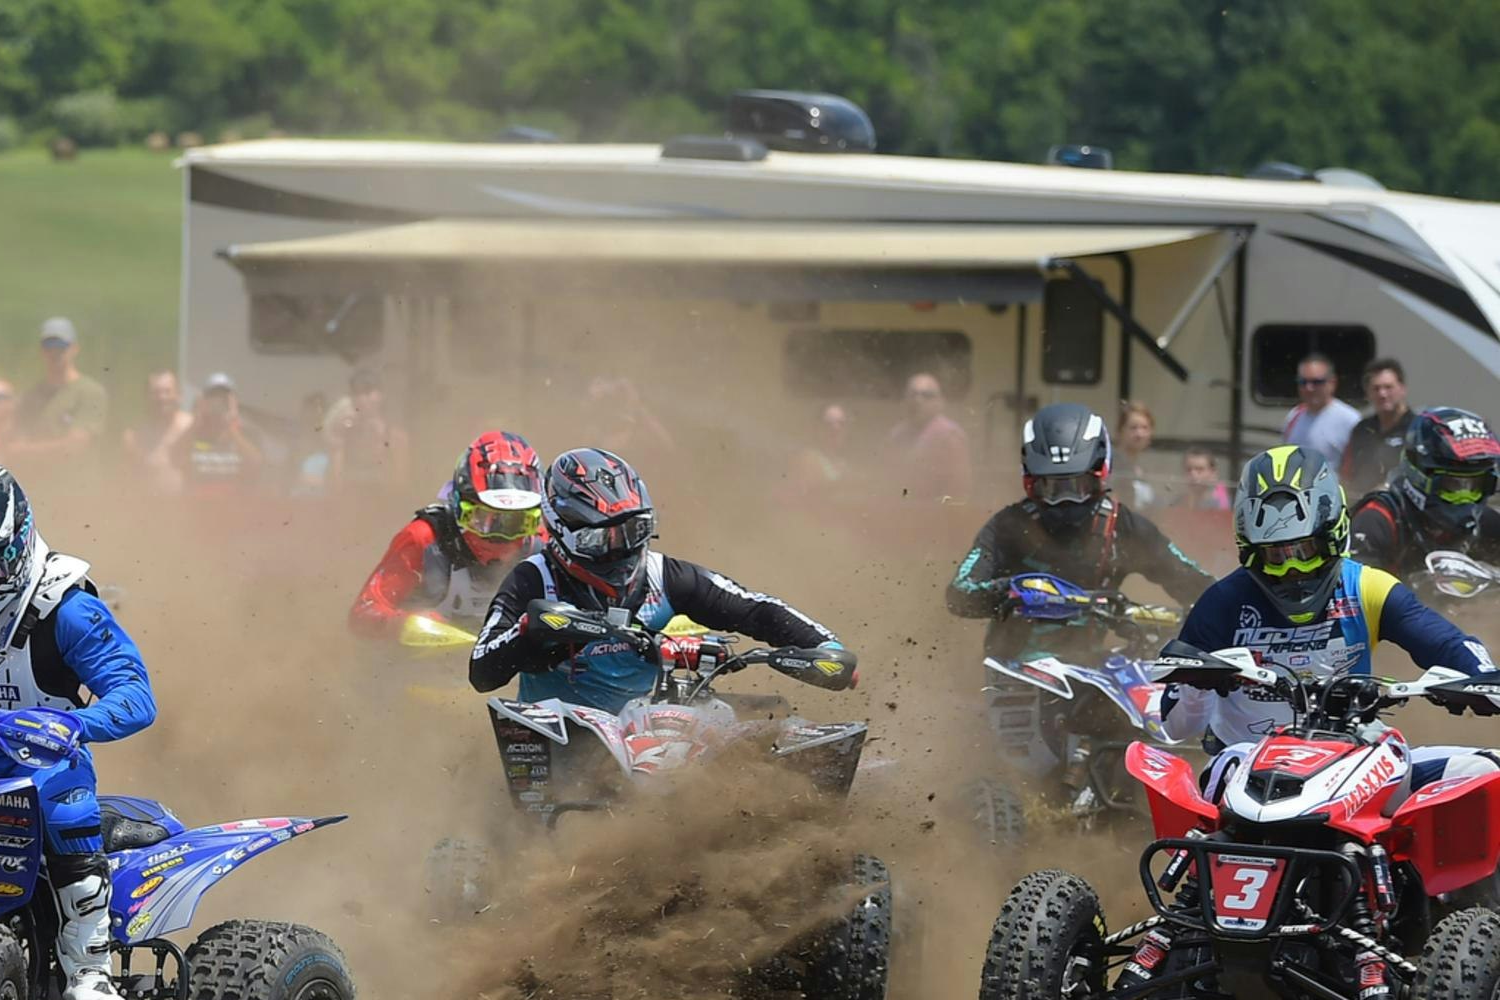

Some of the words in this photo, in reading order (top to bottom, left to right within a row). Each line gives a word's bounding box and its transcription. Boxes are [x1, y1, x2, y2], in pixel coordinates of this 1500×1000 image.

[1232, 620, 1336, 646] MOOSE
[1267, 640, 1329, 654] RACING
[1463, 684, 1500, 693] ACER
[507, 743, 542, 753] ACTION
[1341, 755, 1395, 821] MAXXIS
[1223, 868, 1268, 910] 3
[1223, 919, 1259, 928] BOICH
[1359, 985, 1389, 1000] Elka
